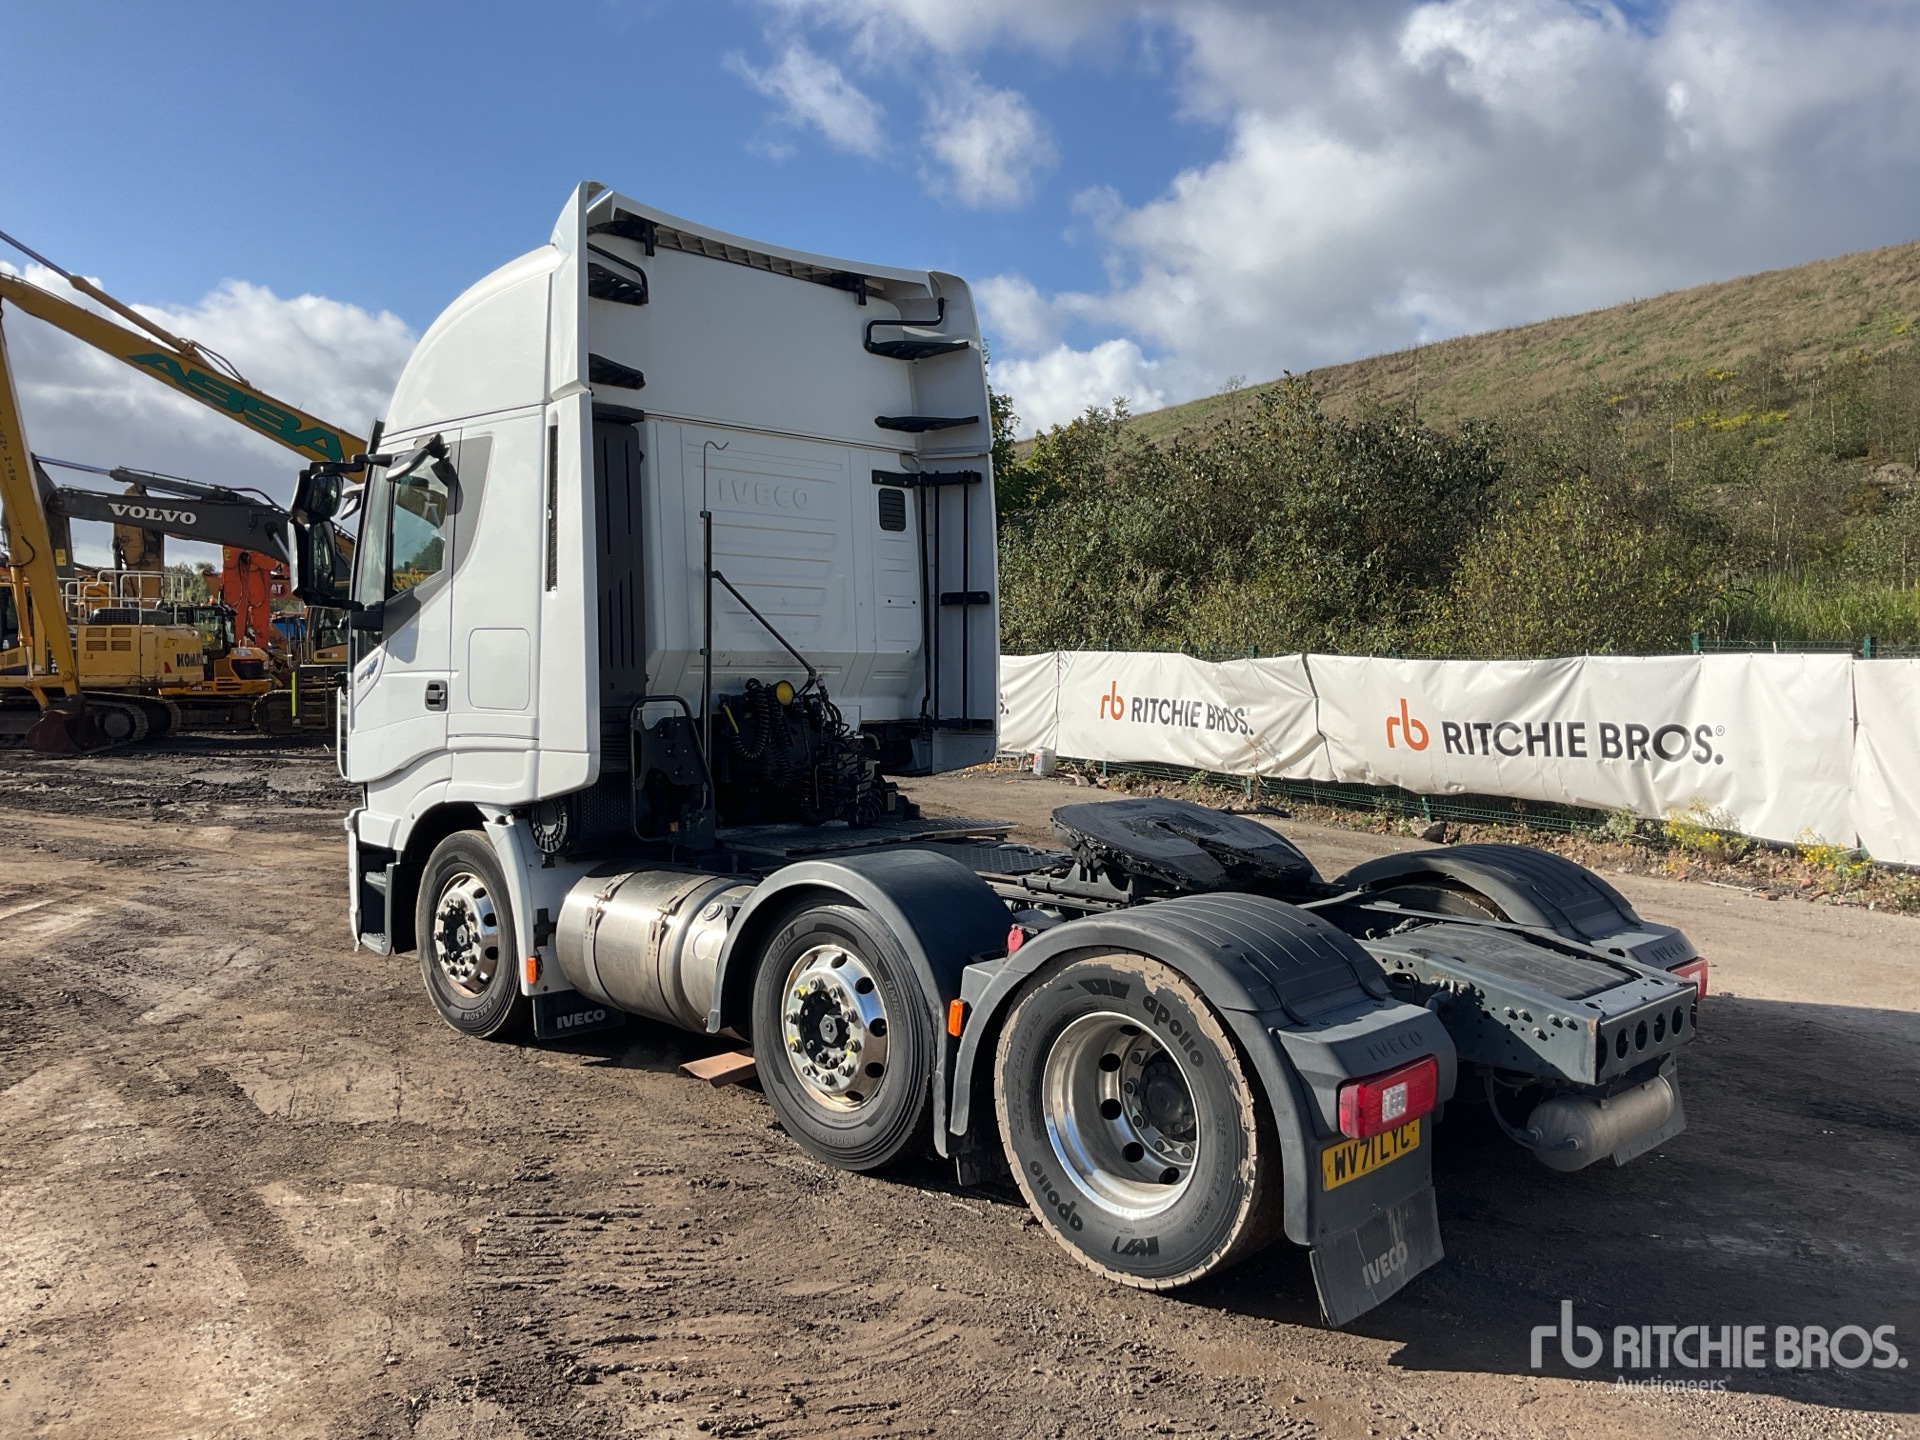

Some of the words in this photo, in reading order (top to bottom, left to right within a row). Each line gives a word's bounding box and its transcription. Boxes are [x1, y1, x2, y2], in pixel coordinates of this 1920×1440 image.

[108, 503, 197, 525] VOLVO
[717, 478, 808, 510] IVECO
[270, 583, 282, 595] AT
[1100, 681, 1124, 720] rb
[1131, 697, 1202, 728] RITCHIE
[1205, 703, 1254, 735] BROS.
[1386, 698, 1429, 751] rb
[1442, 721, 1587, 759] RITCHIE
[1599, 722, 1723, 765] BROS.
[556, 1008, 606, 1030] IVECO
[1143, 996, 1204, 1067] apollo
[1366, 1031, 1424, 1062] IVECO
[1030, 1161, 1083, 1231] apollo
[1362, 1241, 1408, 1289] IVECO
